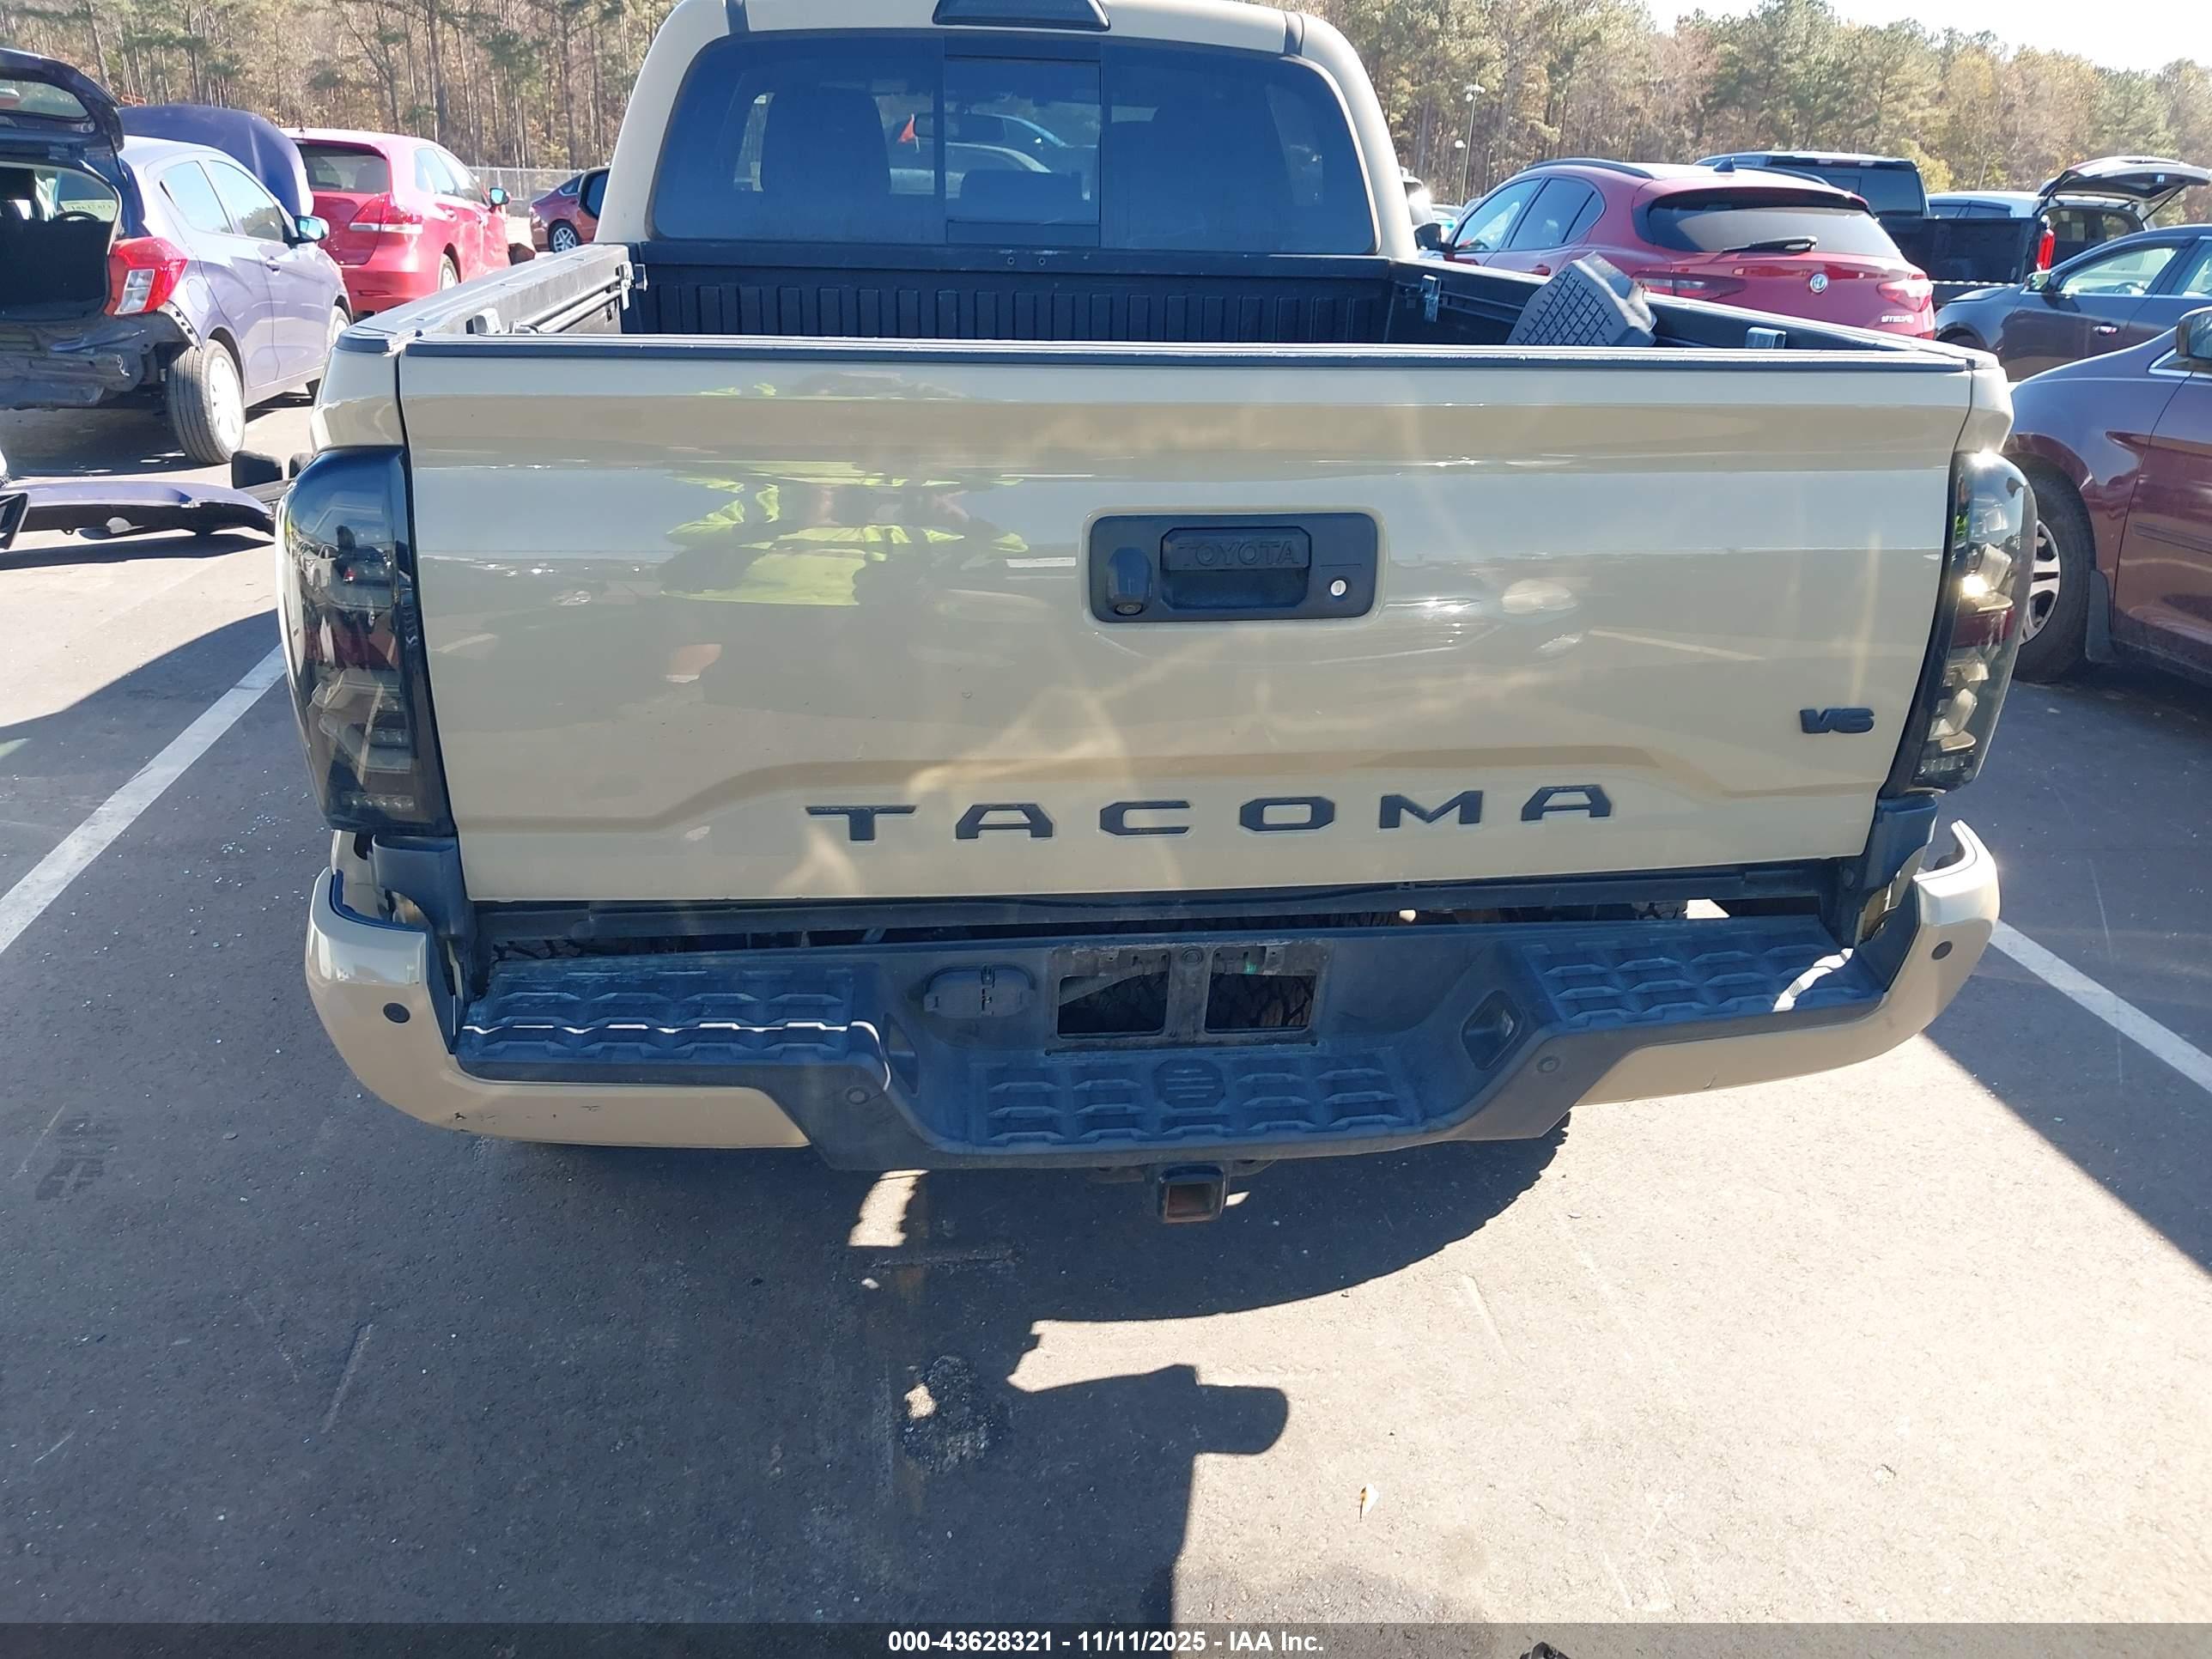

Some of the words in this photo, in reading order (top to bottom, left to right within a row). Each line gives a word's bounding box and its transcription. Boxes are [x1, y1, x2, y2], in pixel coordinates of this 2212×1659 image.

[1177, 540, 1300, 566] TOYOTA
[1799, 708, 1875, 734] V6
[805, 783, 1613, 842] TACOMA
